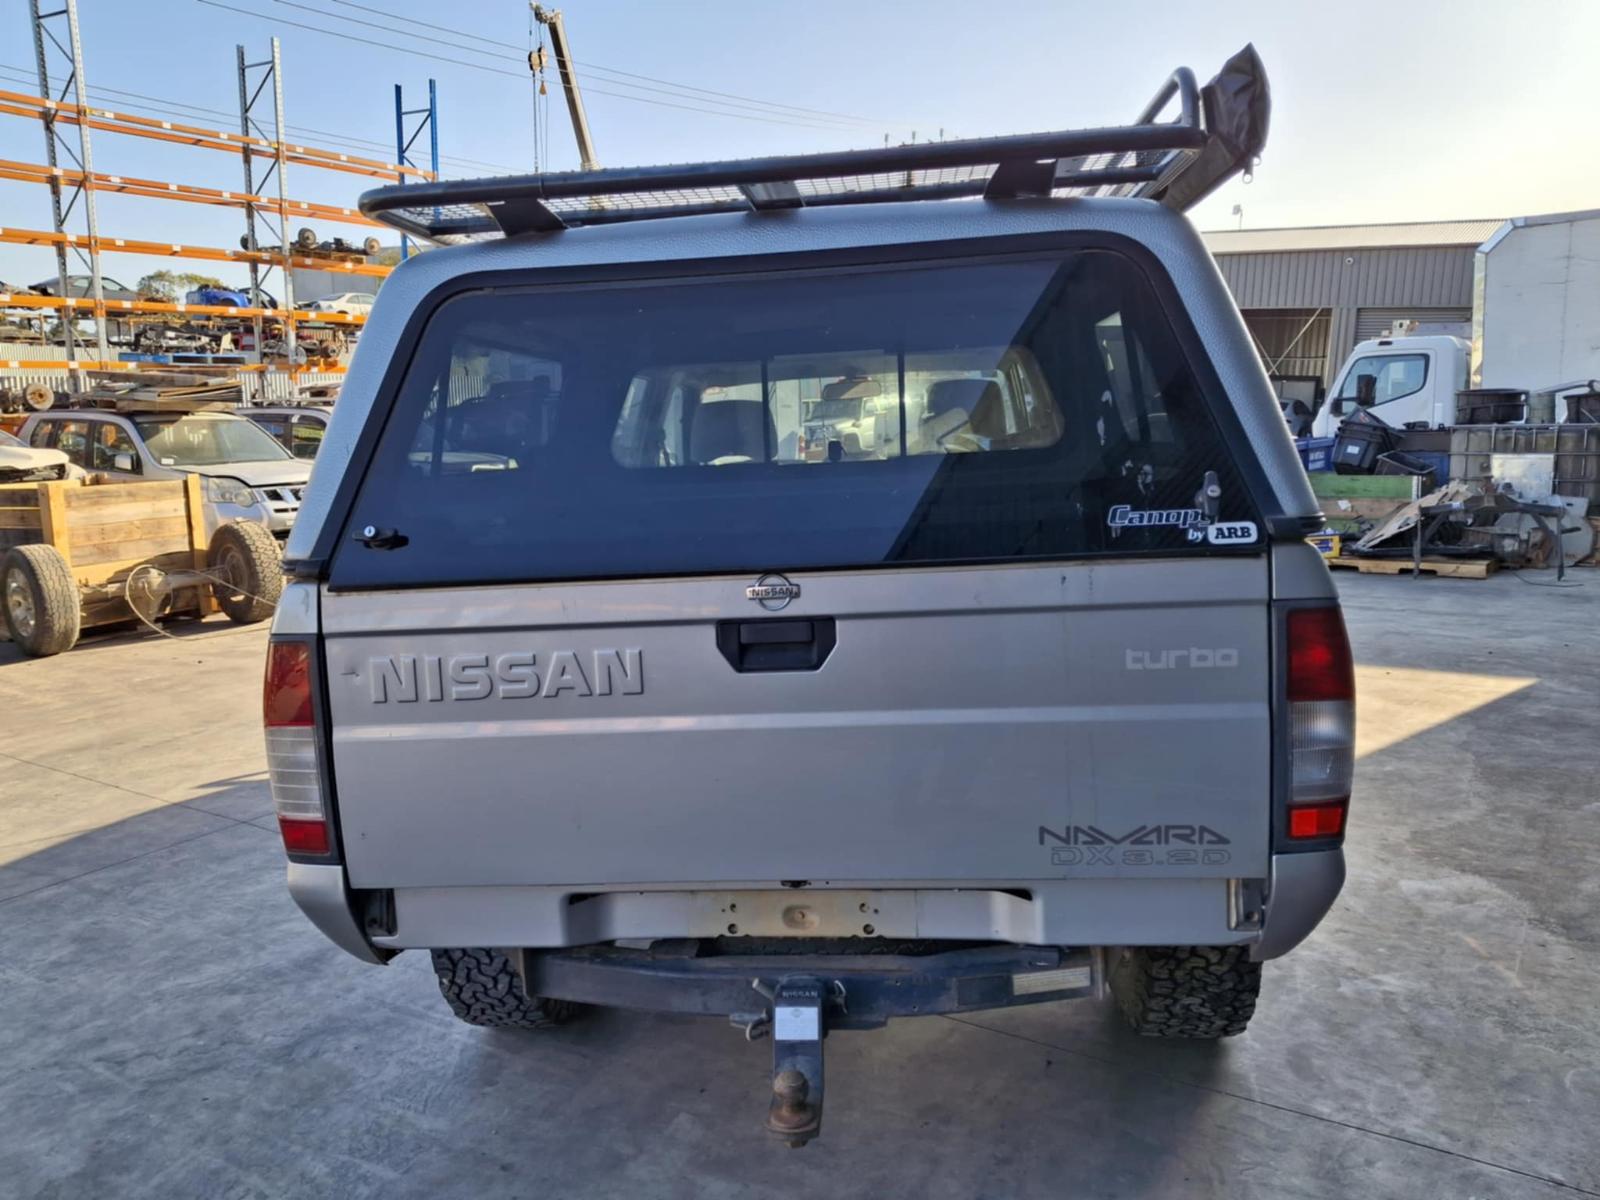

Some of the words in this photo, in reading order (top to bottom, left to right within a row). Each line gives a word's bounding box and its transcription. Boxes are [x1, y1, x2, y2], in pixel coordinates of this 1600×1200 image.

[1187, 528, 1206, 543] by
[1214, 525, 1252, 540] ARB
[752, 587, 794, 597] NISSAN
[1125, 647, 1239, 670] turbo
[369, 649, 645, 704] NISSAN
[1039, 825, 1231, 846] NAVARA
[1051, 846, 1115, 866] DX
